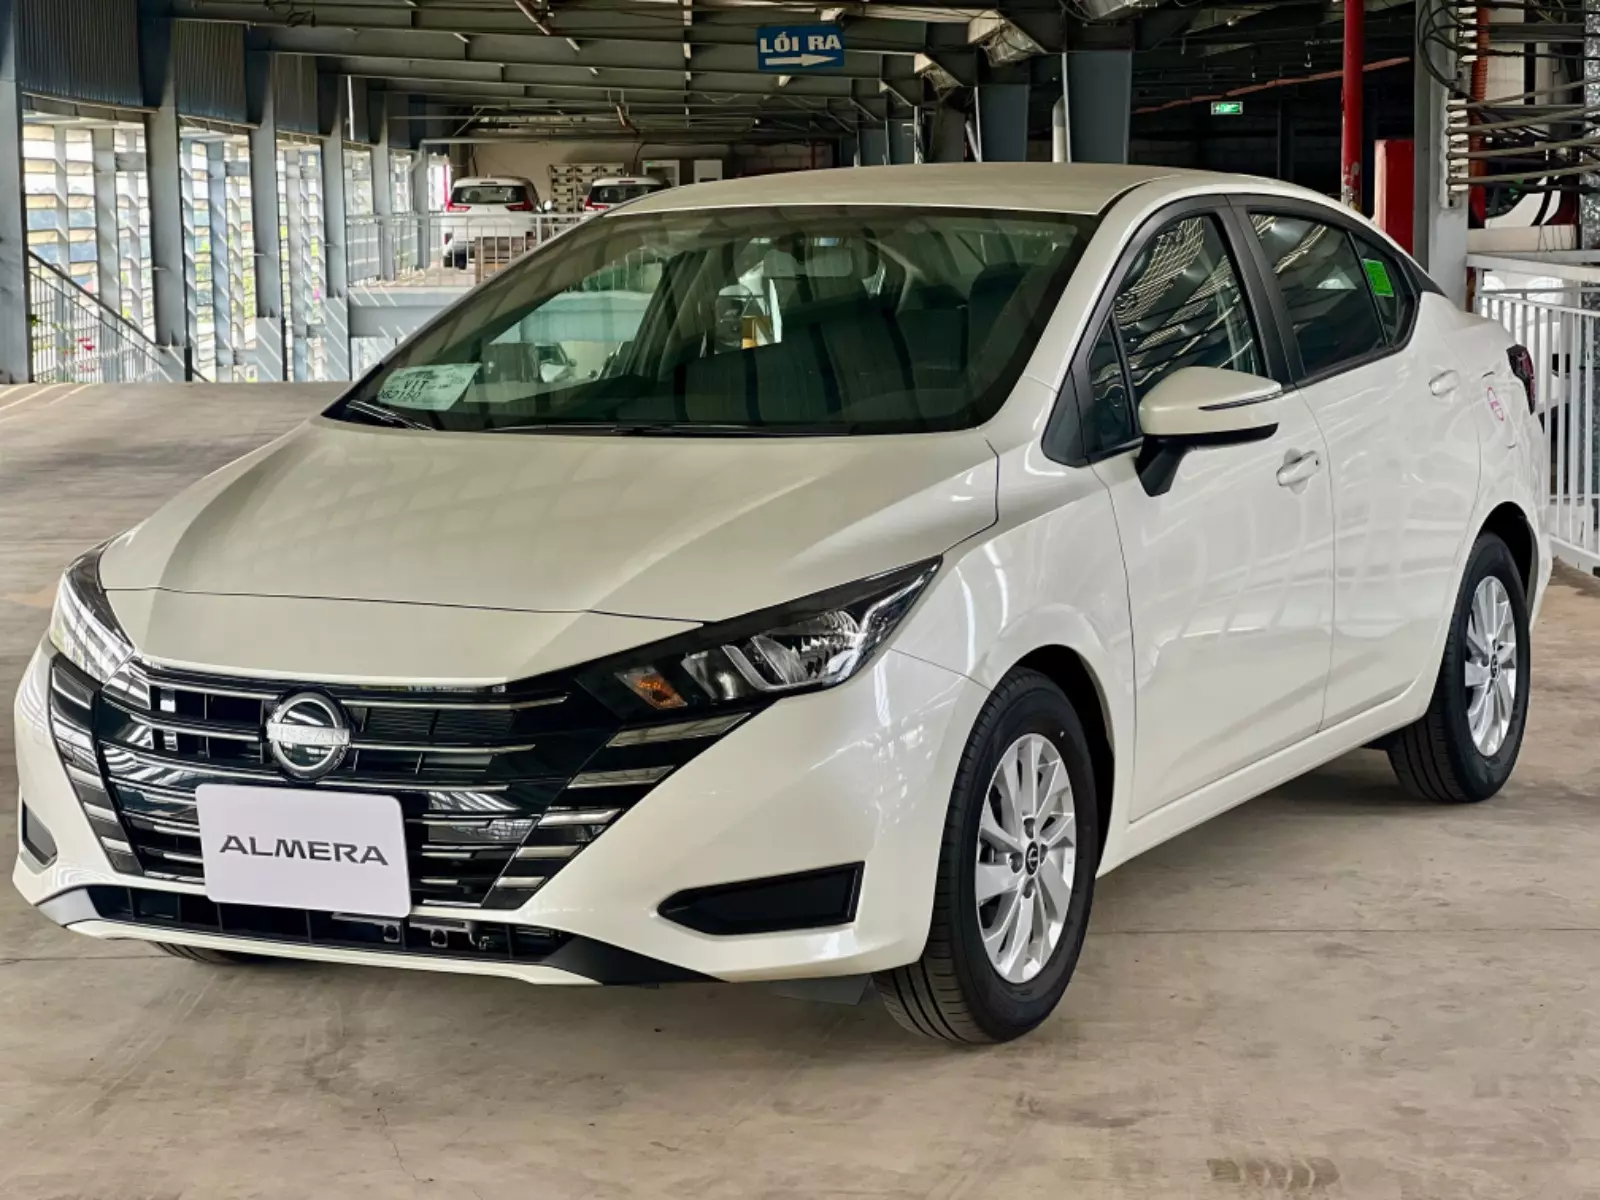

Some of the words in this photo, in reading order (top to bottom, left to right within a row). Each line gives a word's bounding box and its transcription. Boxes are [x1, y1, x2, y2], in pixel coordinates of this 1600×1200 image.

[760, 32, 799, 53] LỐI
[808, 34, 841, 51] RA
[219, 834, 390, 867] ALMERA
